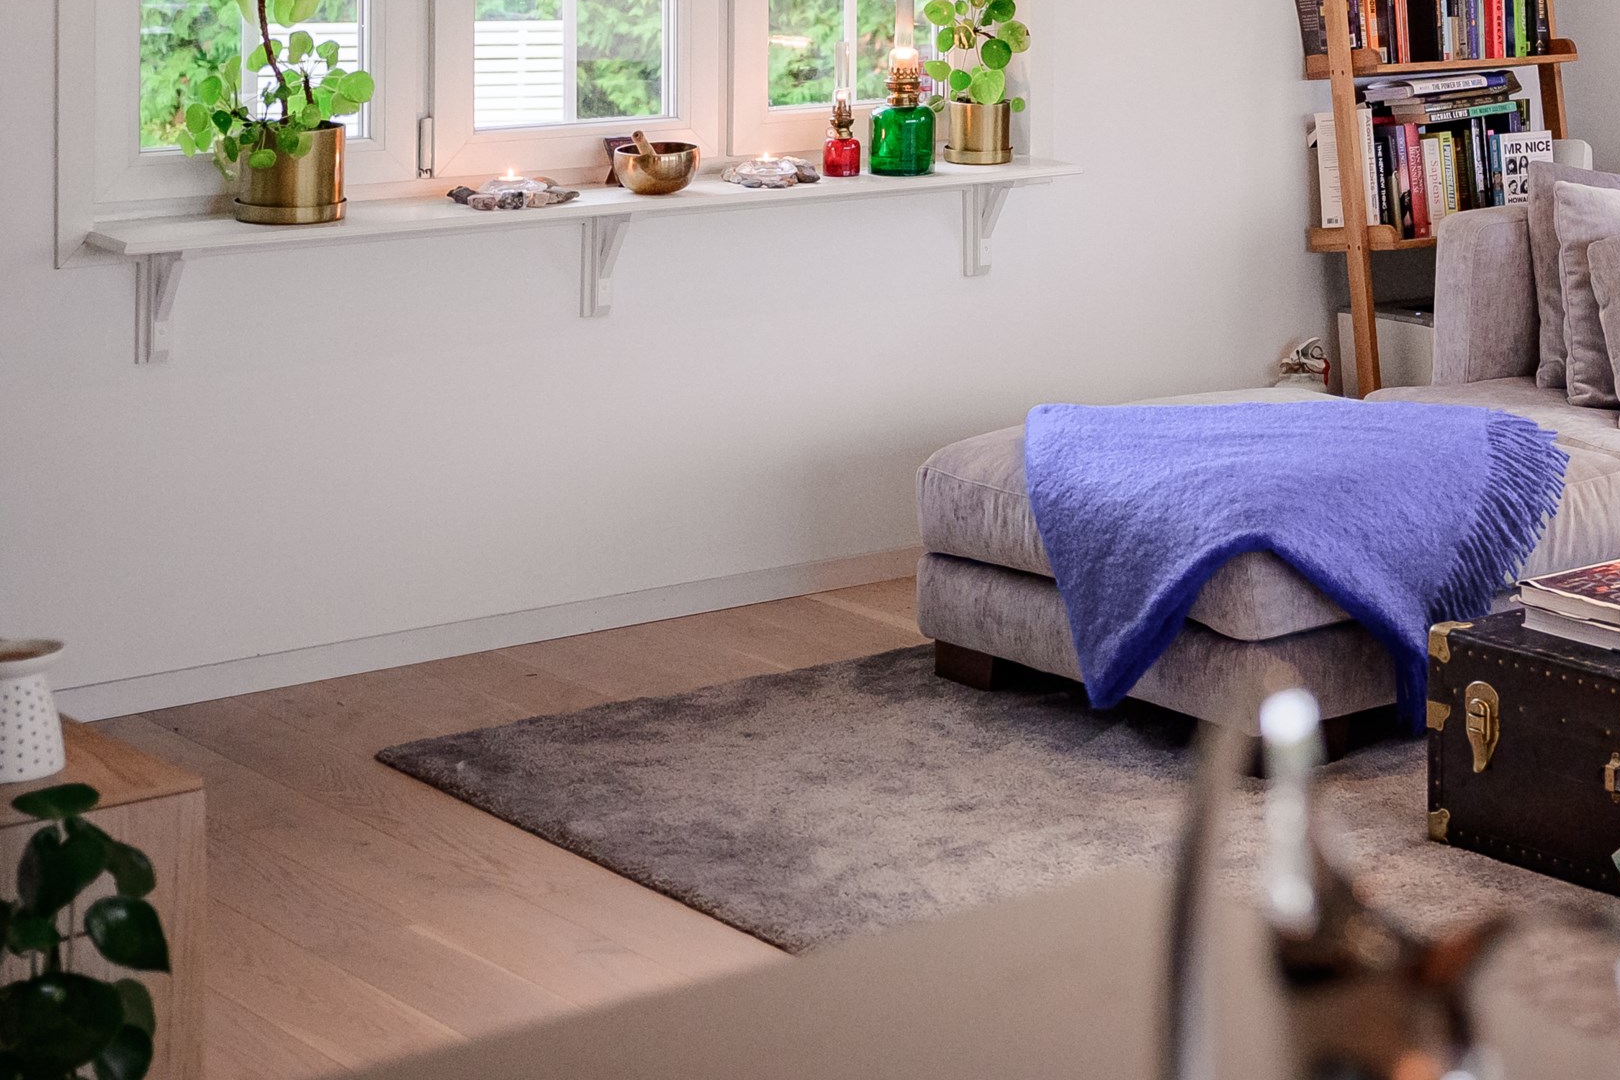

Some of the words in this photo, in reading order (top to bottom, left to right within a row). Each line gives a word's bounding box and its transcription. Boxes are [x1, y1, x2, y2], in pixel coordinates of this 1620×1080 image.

[1496, 1, 1501, 11] TO
[1441, 82, 1455, 90] POWER
[1431, 112, 1453, 121] MICHAEL
[1453, 110, 1467, 118] LEWIS
[1479, 106, 1491, 114] MONEY
[1365, 115, 1373, 154] Atomic
[1504, 143, 1522, 154] MR
[1525, 141, 1550, 153] NICE
[1368, 157, 1376, 191] Habits
[1430, 160, 1441, 204] Sapiens
